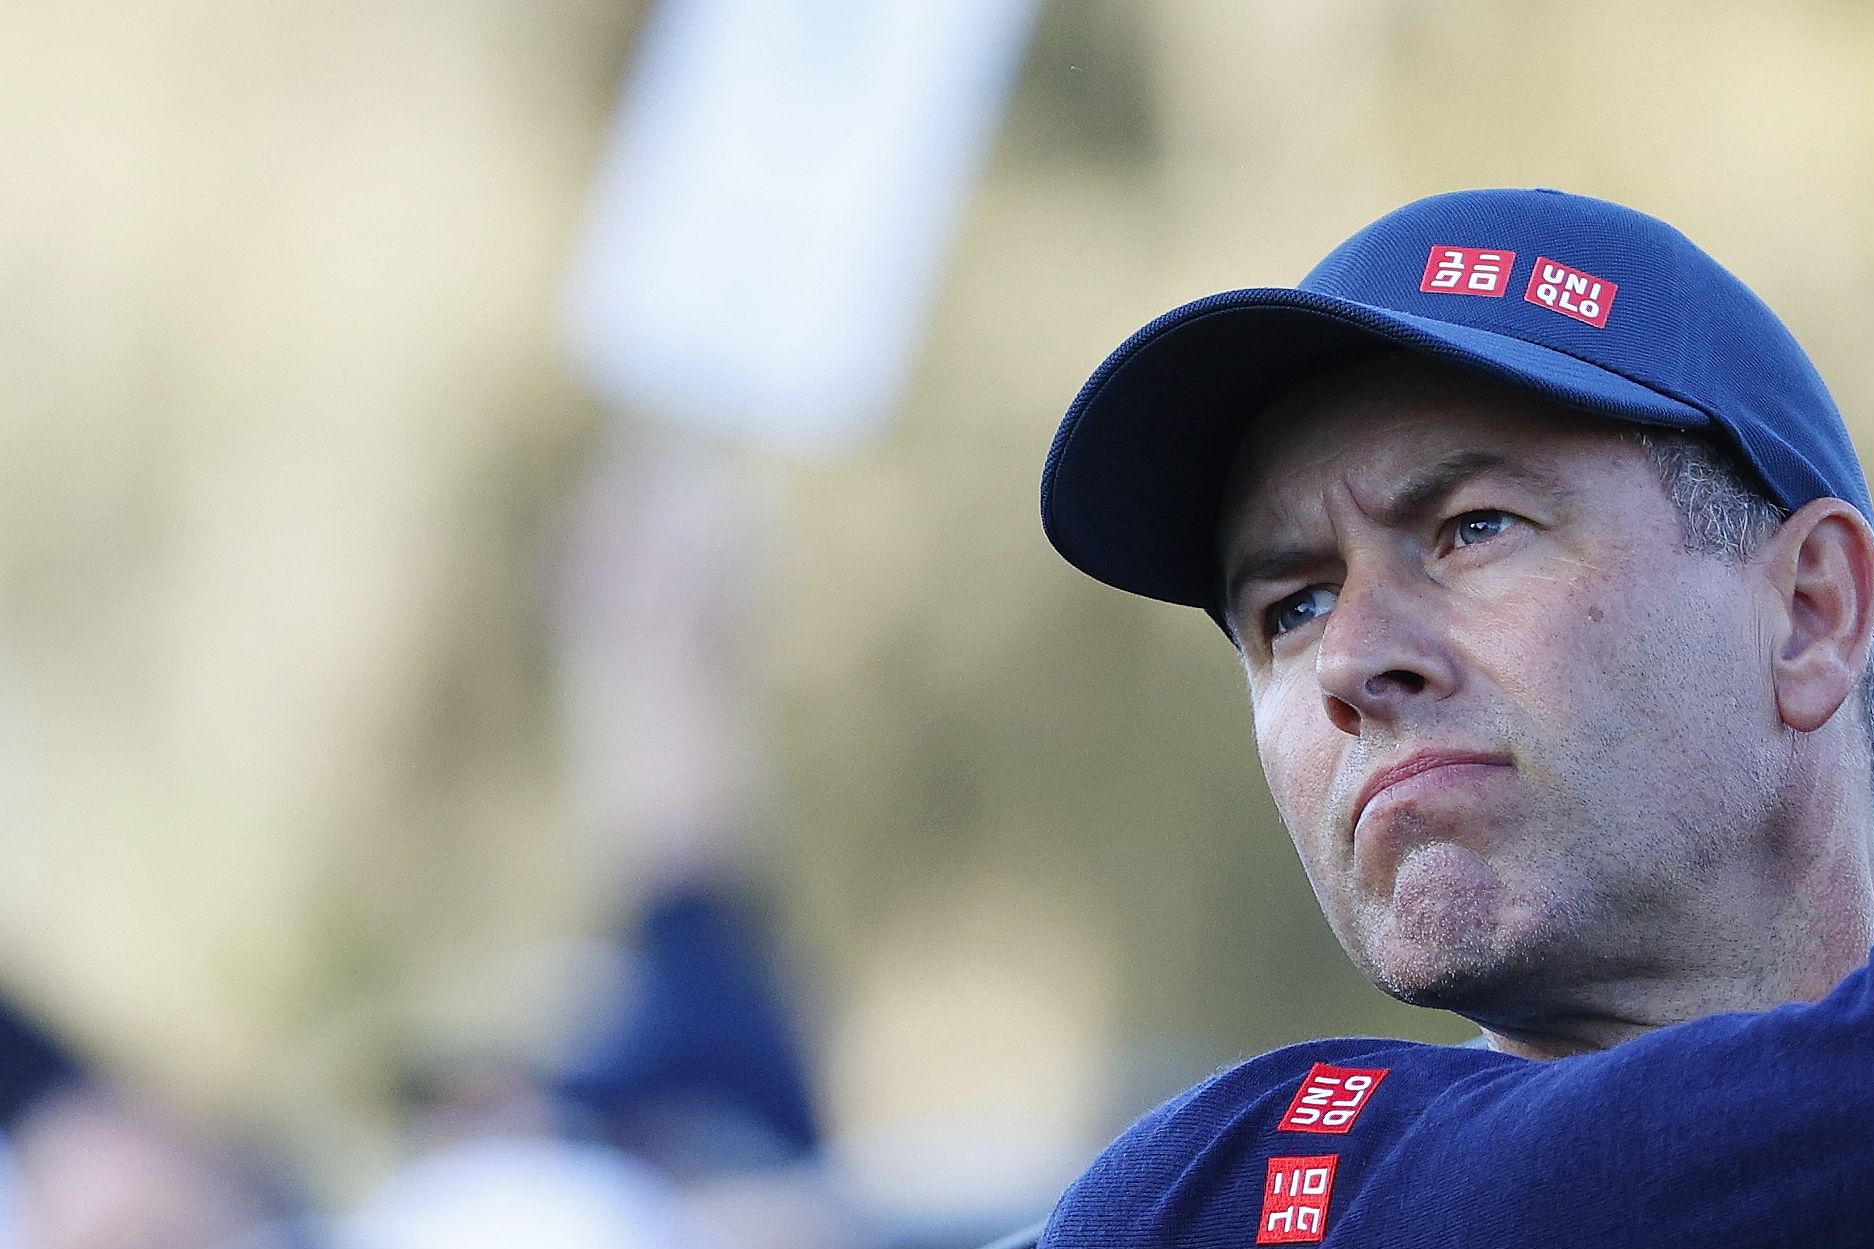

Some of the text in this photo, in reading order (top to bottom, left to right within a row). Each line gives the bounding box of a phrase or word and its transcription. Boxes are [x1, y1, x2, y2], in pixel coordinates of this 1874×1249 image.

[1536, 283, 1600, 318] QLO
[1542, 264, 1602, 300] UNI
[1290, 1075, 1341, 1125] UNI
[1322, 1075, 1372, 1126] QLO
